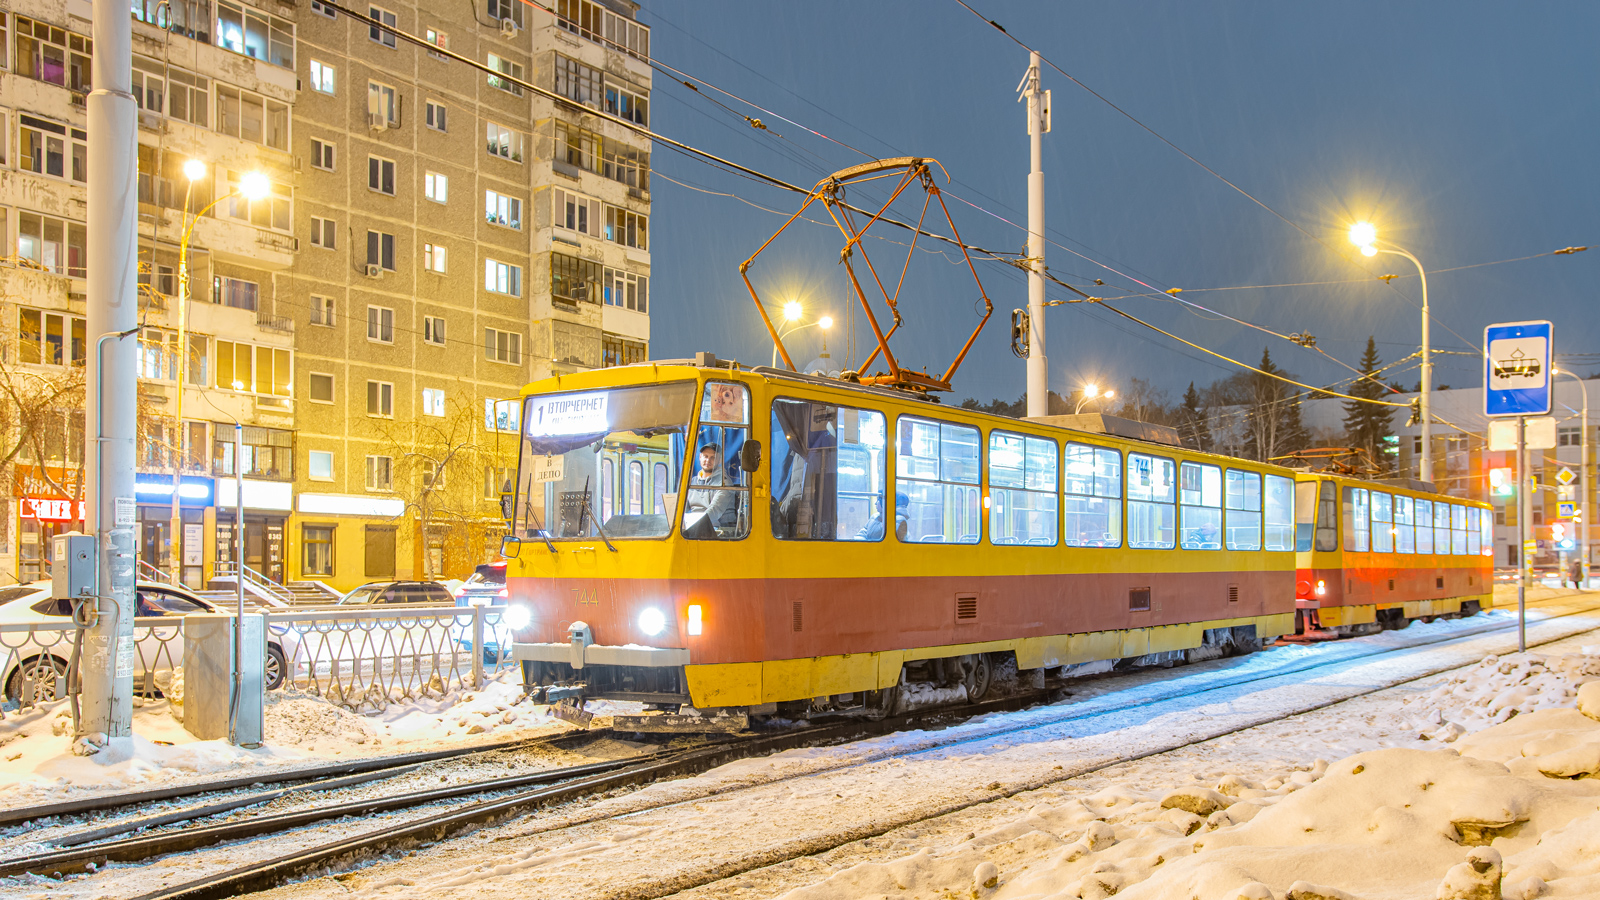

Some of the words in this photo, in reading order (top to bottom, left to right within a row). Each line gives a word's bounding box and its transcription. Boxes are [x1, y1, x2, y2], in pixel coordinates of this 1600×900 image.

[538, 405, 544, 425] 1
[548, 397, 604, 414] ВТОРЧЕРМЕТ
[547, 459, 552, 467] В
[1135, 458, 1149, 474] 744
[537, 470, 561, 481] ДЕПО
[571, 588, 599, 607] 744
